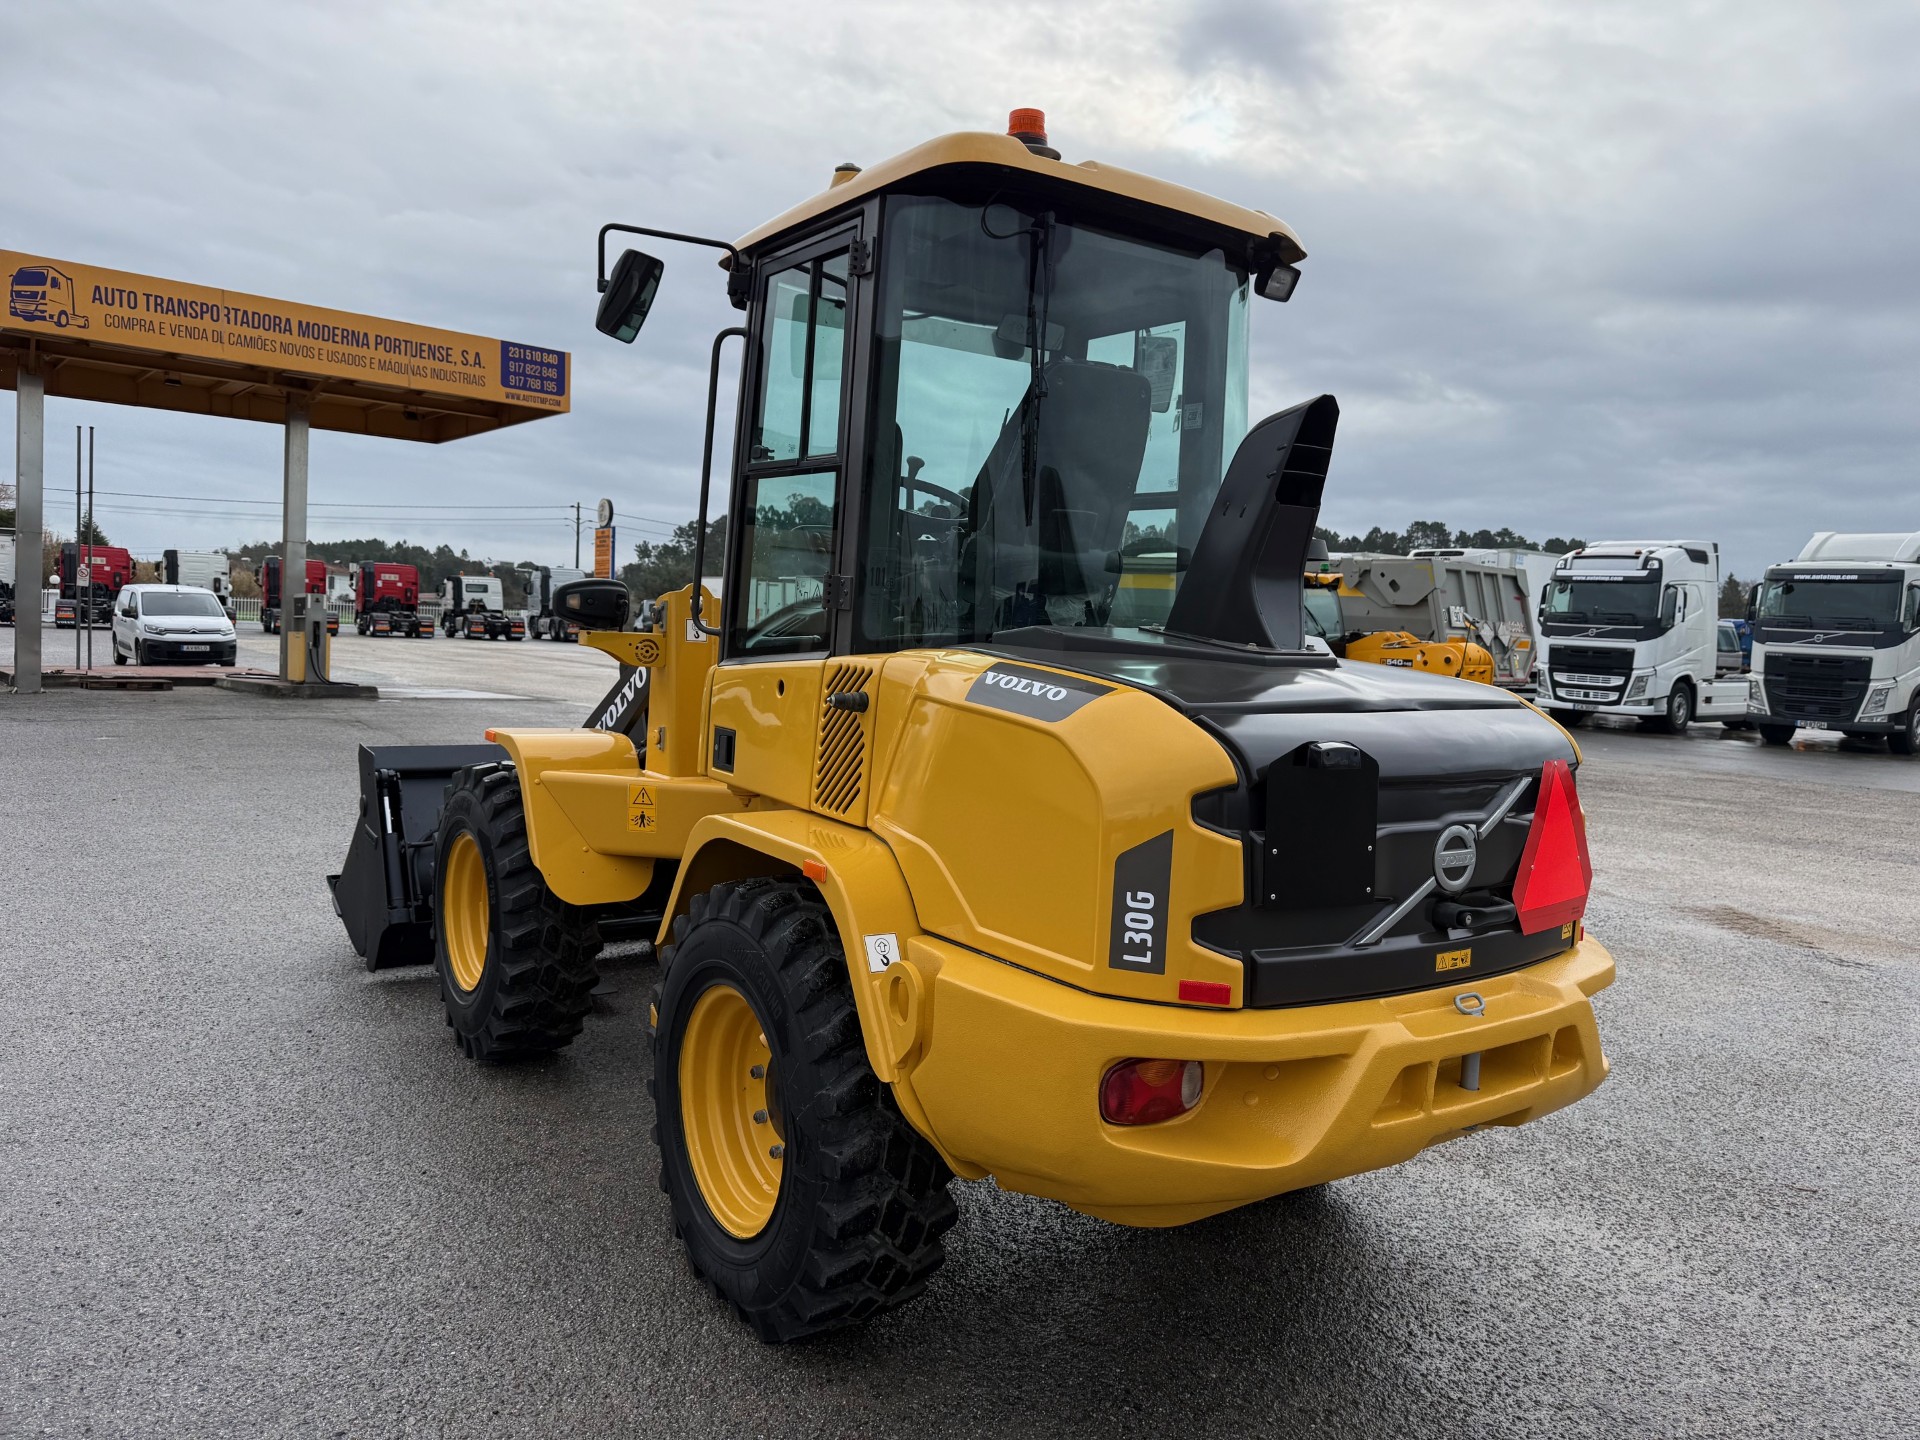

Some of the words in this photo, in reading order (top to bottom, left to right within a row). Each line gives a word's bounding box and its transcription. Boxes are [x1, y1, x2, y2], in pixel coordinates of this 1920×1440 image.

[91, 285, 138, 310] AUTO
[297, 319, 370, 350] MODERNA
[374, 334, 457, 367] PORTUENSE,
[461, 349, 486, 370] S.A.
[104, 313, 156, 334] COMPRA
[159, 321, 166, 336] E
[169, 323, 209, 342] VENDA
[228, 332, 277, 353] CAMIÕES
[279, 341, 315, 359] NOVOS
[317, 348, 324, 361] E
[326, 349, 367, 368] USADOS
[369, 356, 376, 370] E
[377, 357, 428, 378] MÁQUINAS
[430, 367, 486, 387] INDUSTRIAIS
[508, 346, 524, 359] 231
[525, 349, 541, 362] 510
[542, 352, 558, 365] 840
[508, 360, 524, 373] 917
[525, 363, 541, 376] 822
[541, 366, 558, 379] 846
[509, 374, 524, 387] 917
[525, 377, 541, 390] 768
[543, 380, 557, 393] 195
[984, 671, 1068, 701] VOLVO
[1122, 891, 1155, 964] L30G
